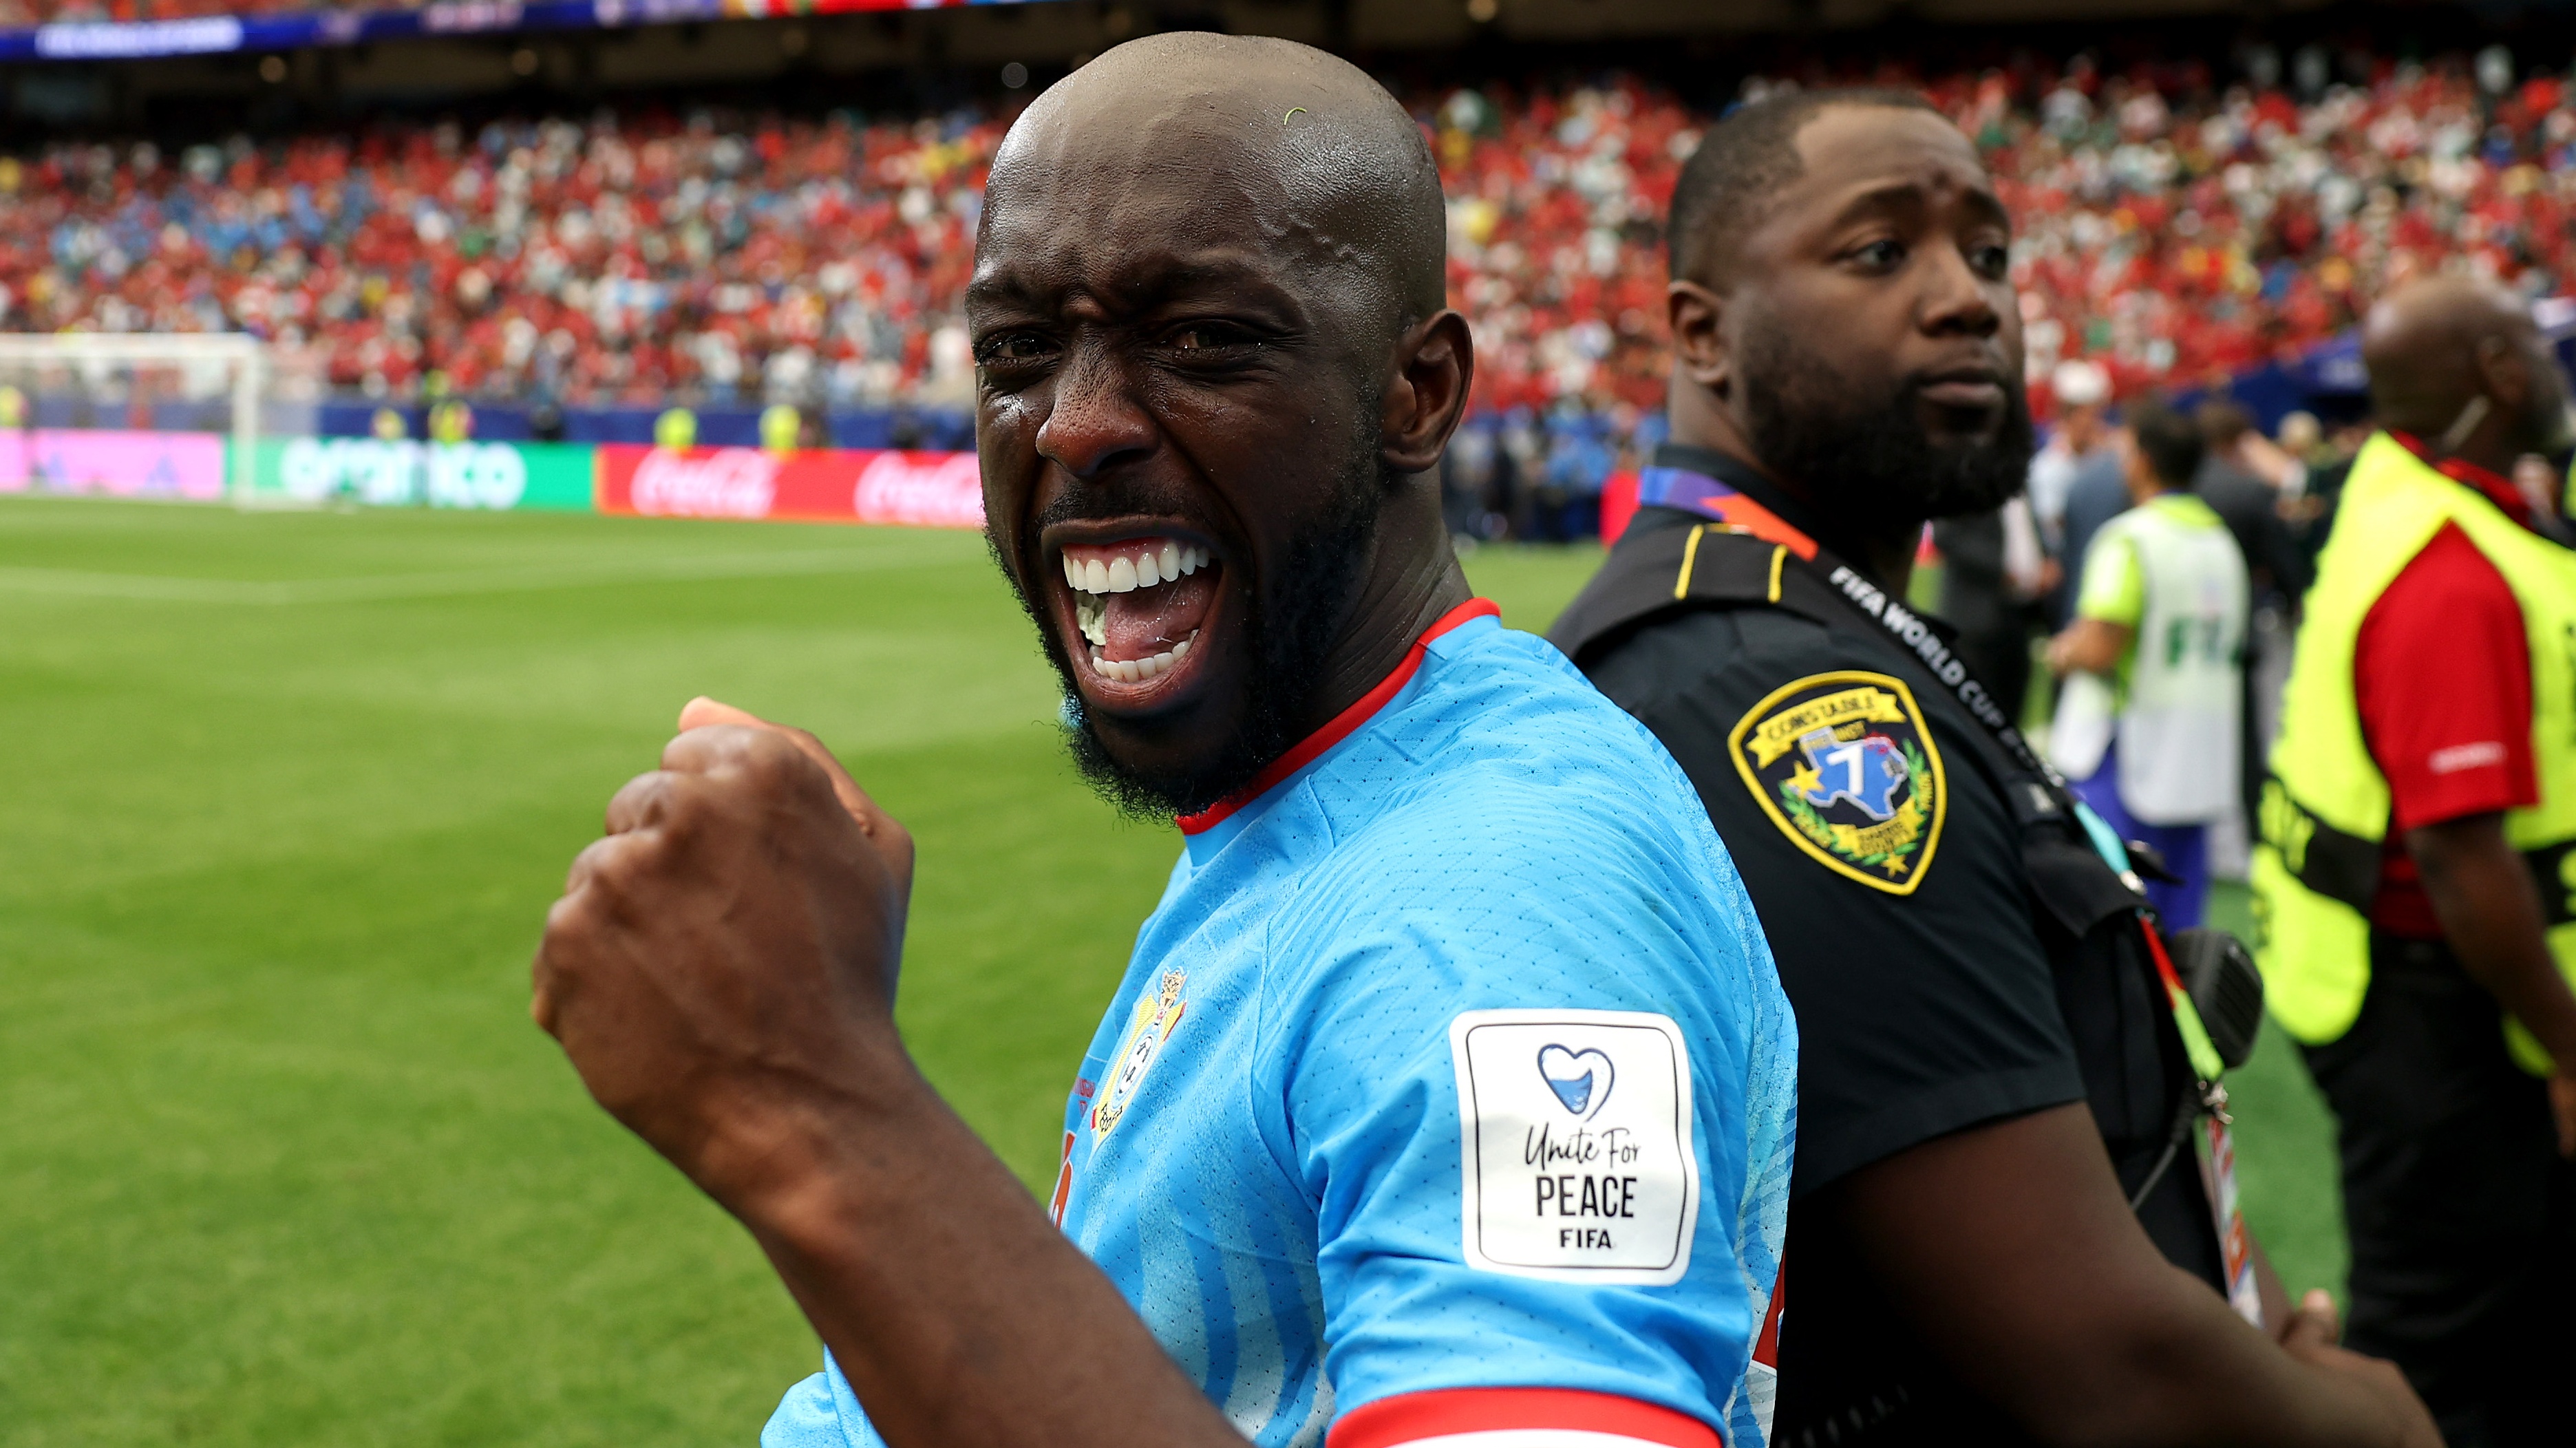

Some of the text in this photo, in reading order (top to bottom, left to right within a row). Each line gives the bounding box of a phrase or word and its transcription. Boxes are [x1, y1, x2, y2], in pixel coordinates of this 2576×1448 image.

[1829, 565, 2005, 727] FIFA WORLD CUP
[1767, 695, 1874, 741] CONSTABLE
[1826, 745, 1866, 796] 7
[1525, 1122, 1641, 1171] Unite For
[1536, 1175, 1637, 1218] PEACE
[1559, 1228, 1612, 1250] FIFA
